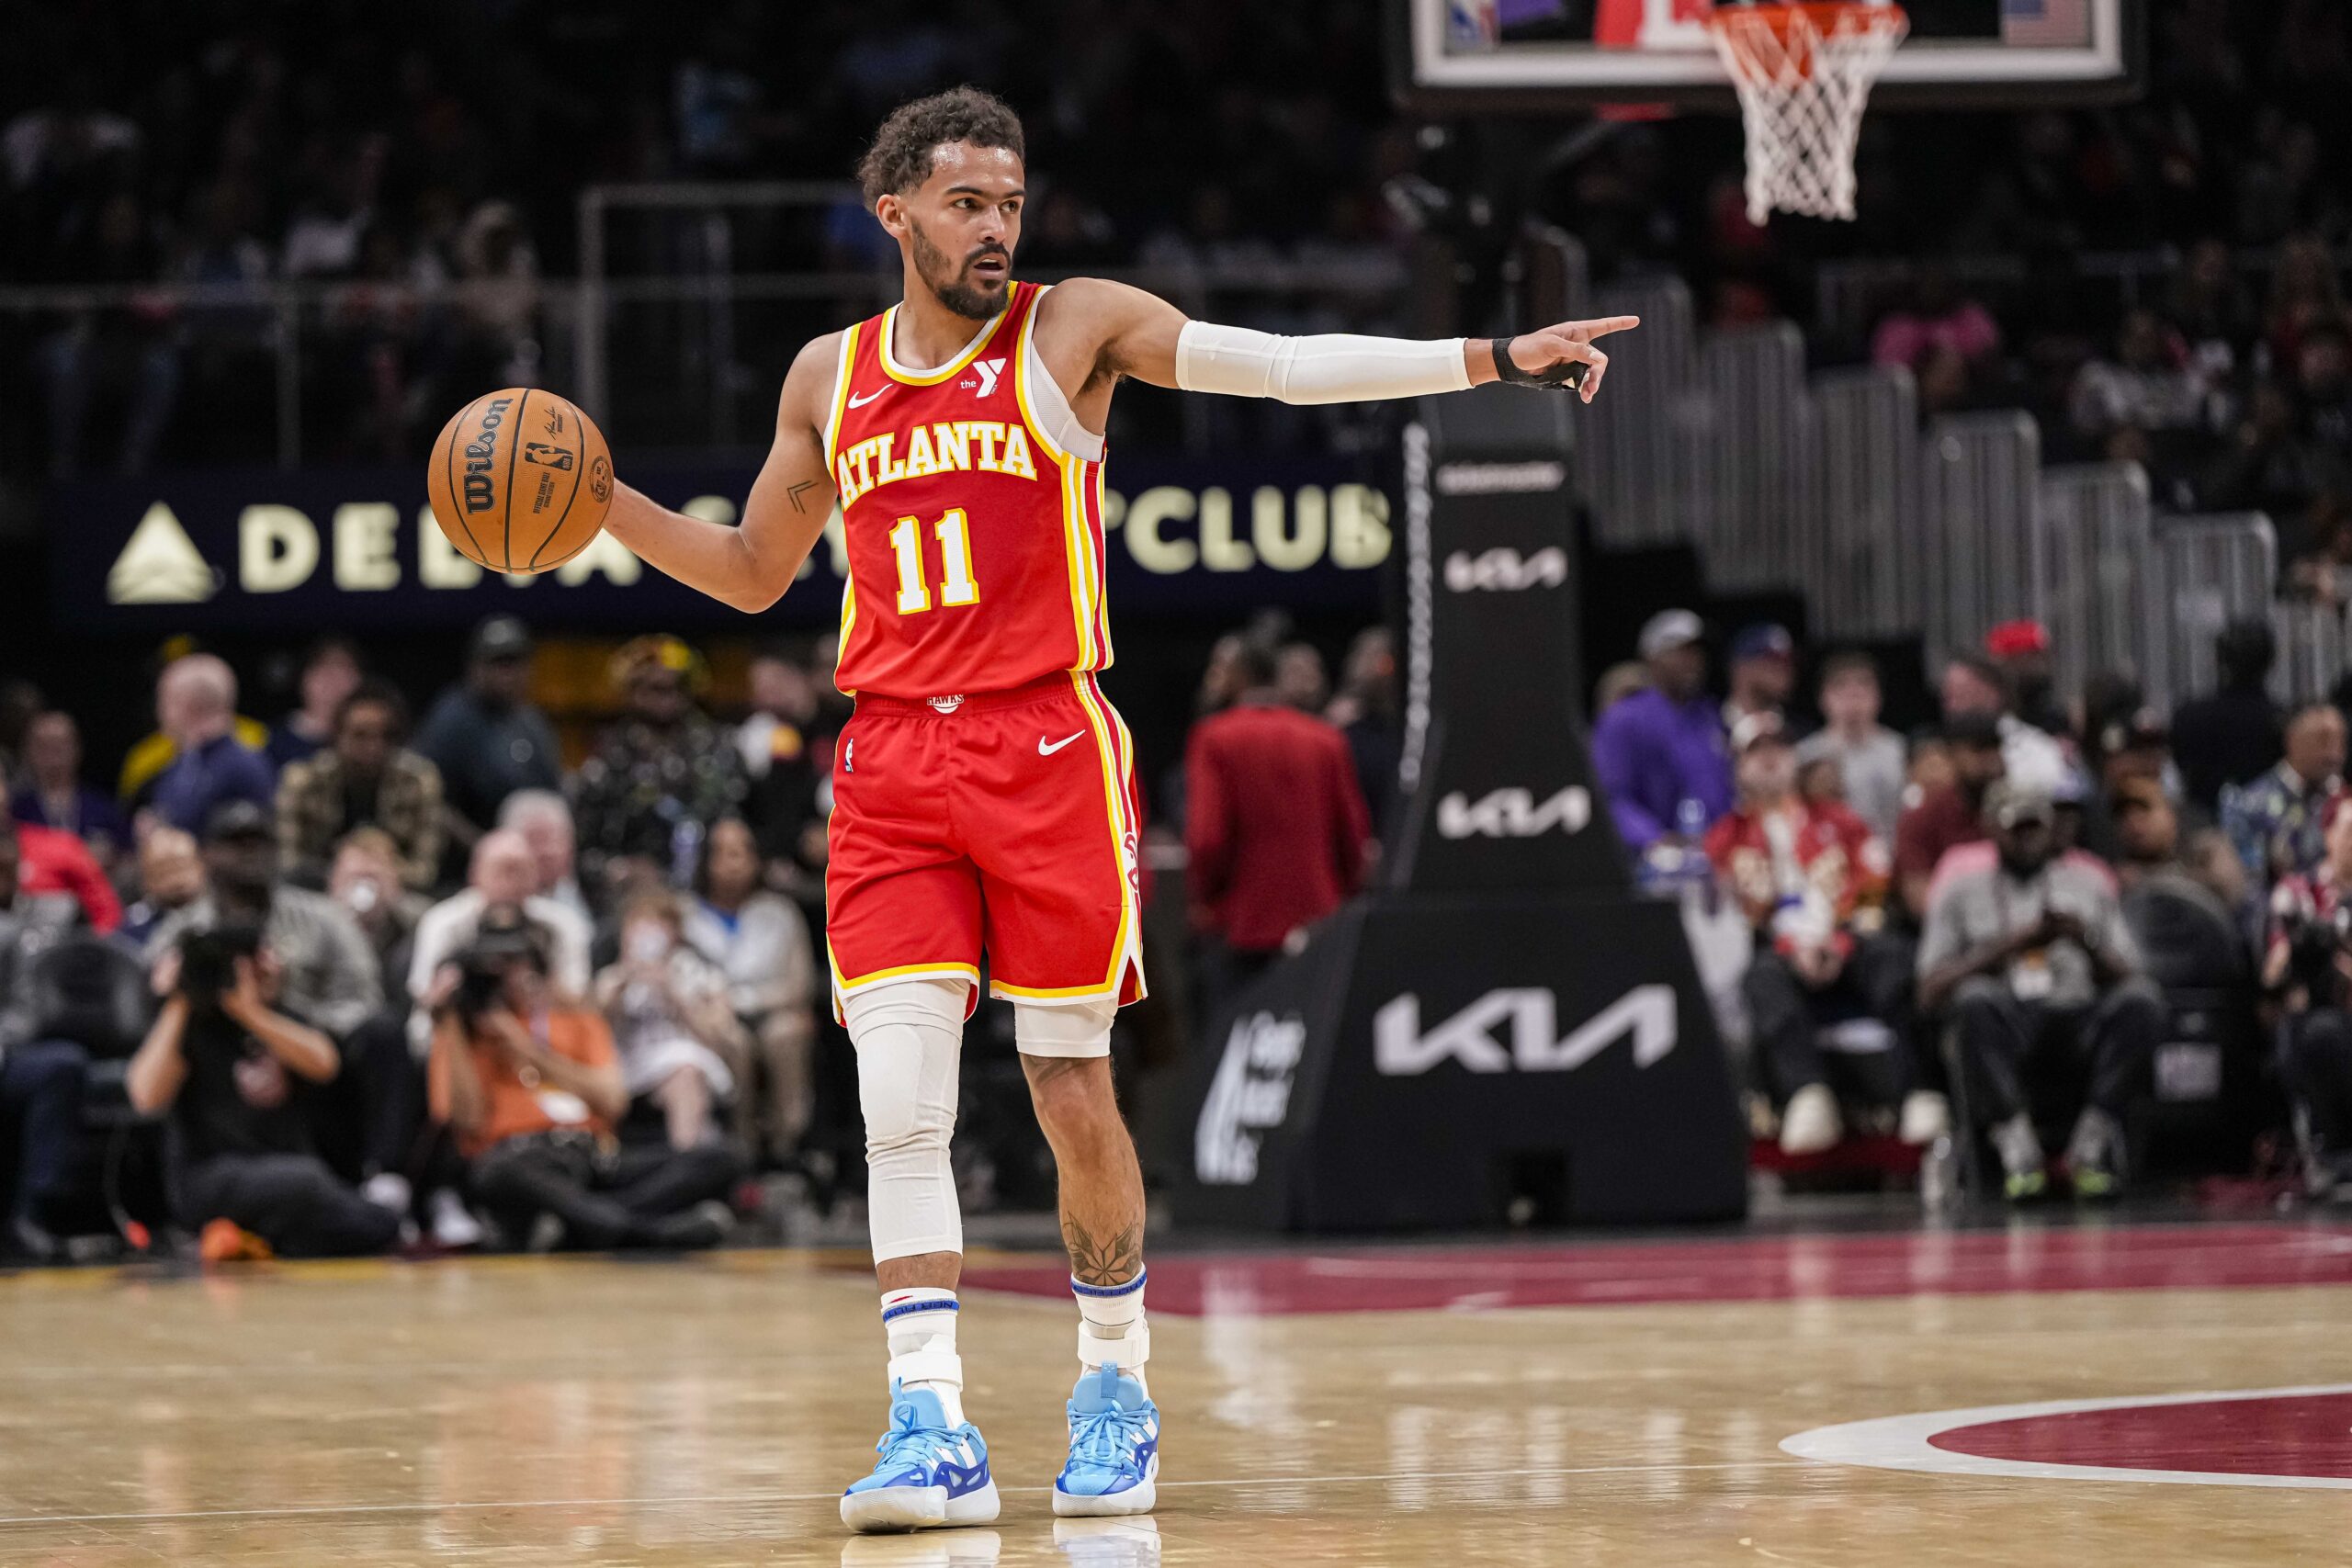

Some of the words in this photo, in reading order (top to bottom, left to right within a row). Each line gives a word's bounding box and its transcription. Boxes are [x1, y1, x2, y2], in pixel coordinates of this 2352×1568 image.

[960, 379, 977, 389] the
[463, 398, 514, 515] Wilson
[837, 421, 1038, 512] ATLANTA
[888, 507, 980, 615] 11
[1124, 483, 1393, 574] CLUB
[927, 694, 965, 705] HAWKS
[1373, 984, 1678, 1076] KIA
